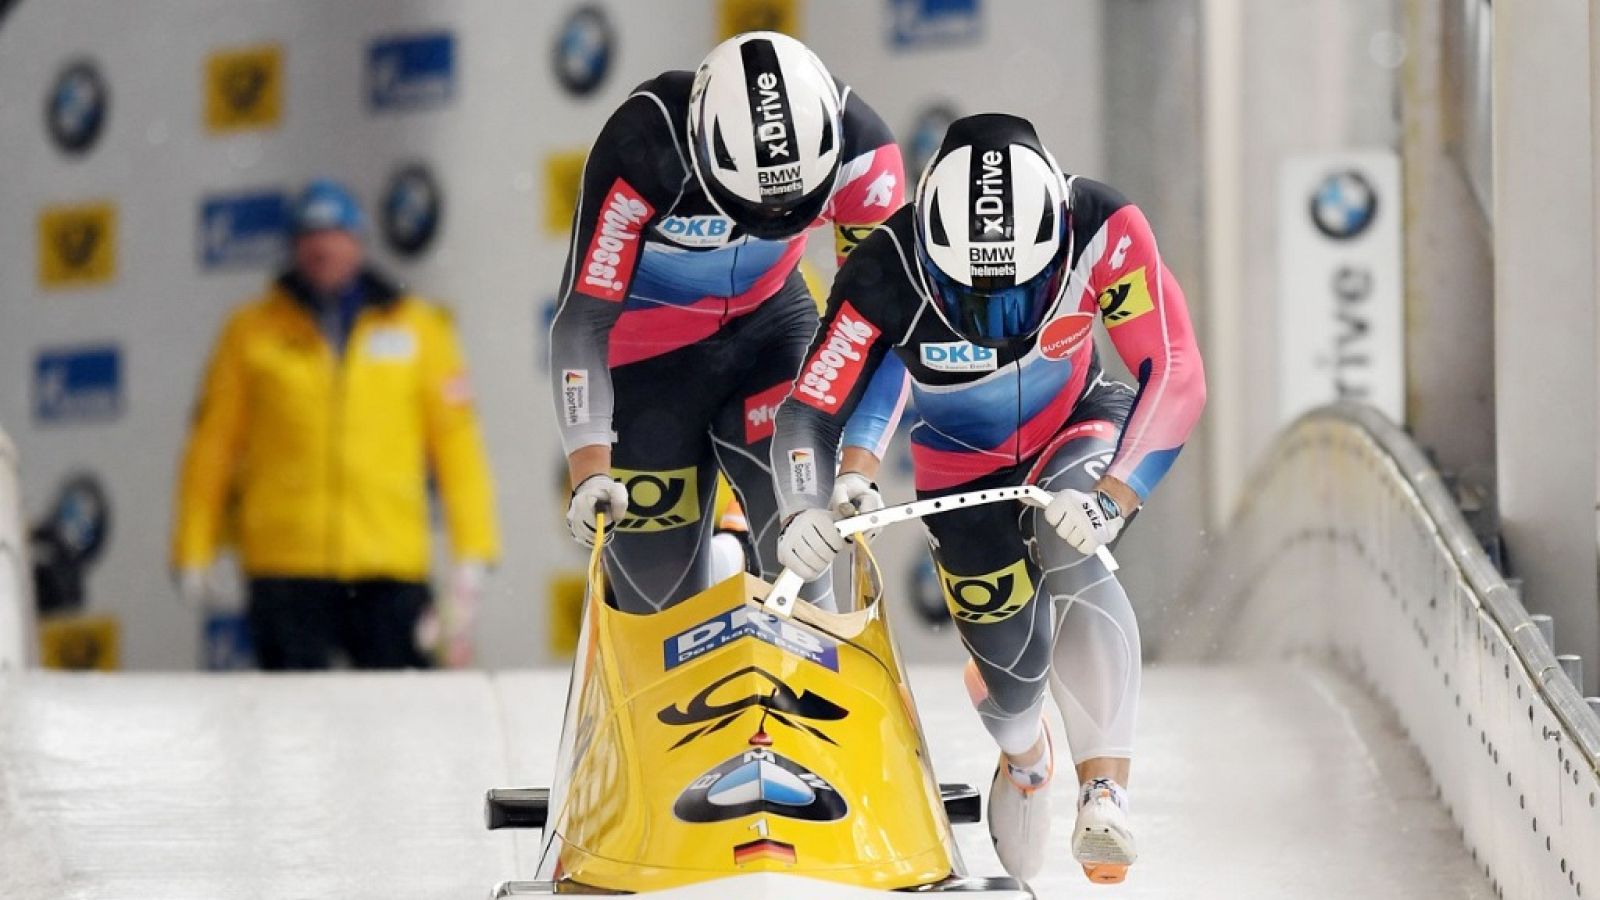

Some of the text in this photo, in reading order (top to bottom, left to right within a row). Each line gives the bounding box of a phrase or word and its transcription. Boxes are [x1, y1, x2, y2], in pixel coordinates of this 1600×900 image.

[756, 72, 790, 159] xDrive
[757, 165, 801, 184] BMW
[760, 181, 803, 196] helmets
[974, 150, 1004, 234] xDrive
[663, 218, 727, 236] DKB
[969, 246, 1015, 262] BMW
[970, 263, 1016, 277] helmets
[1313, 264, 1374, 401] rive
[924, 343, 993, 362] DKB
[677, 606, 825, 654] DKB
[677, 643, 716, 662] Das
[748, 818, 769, 839] 1
